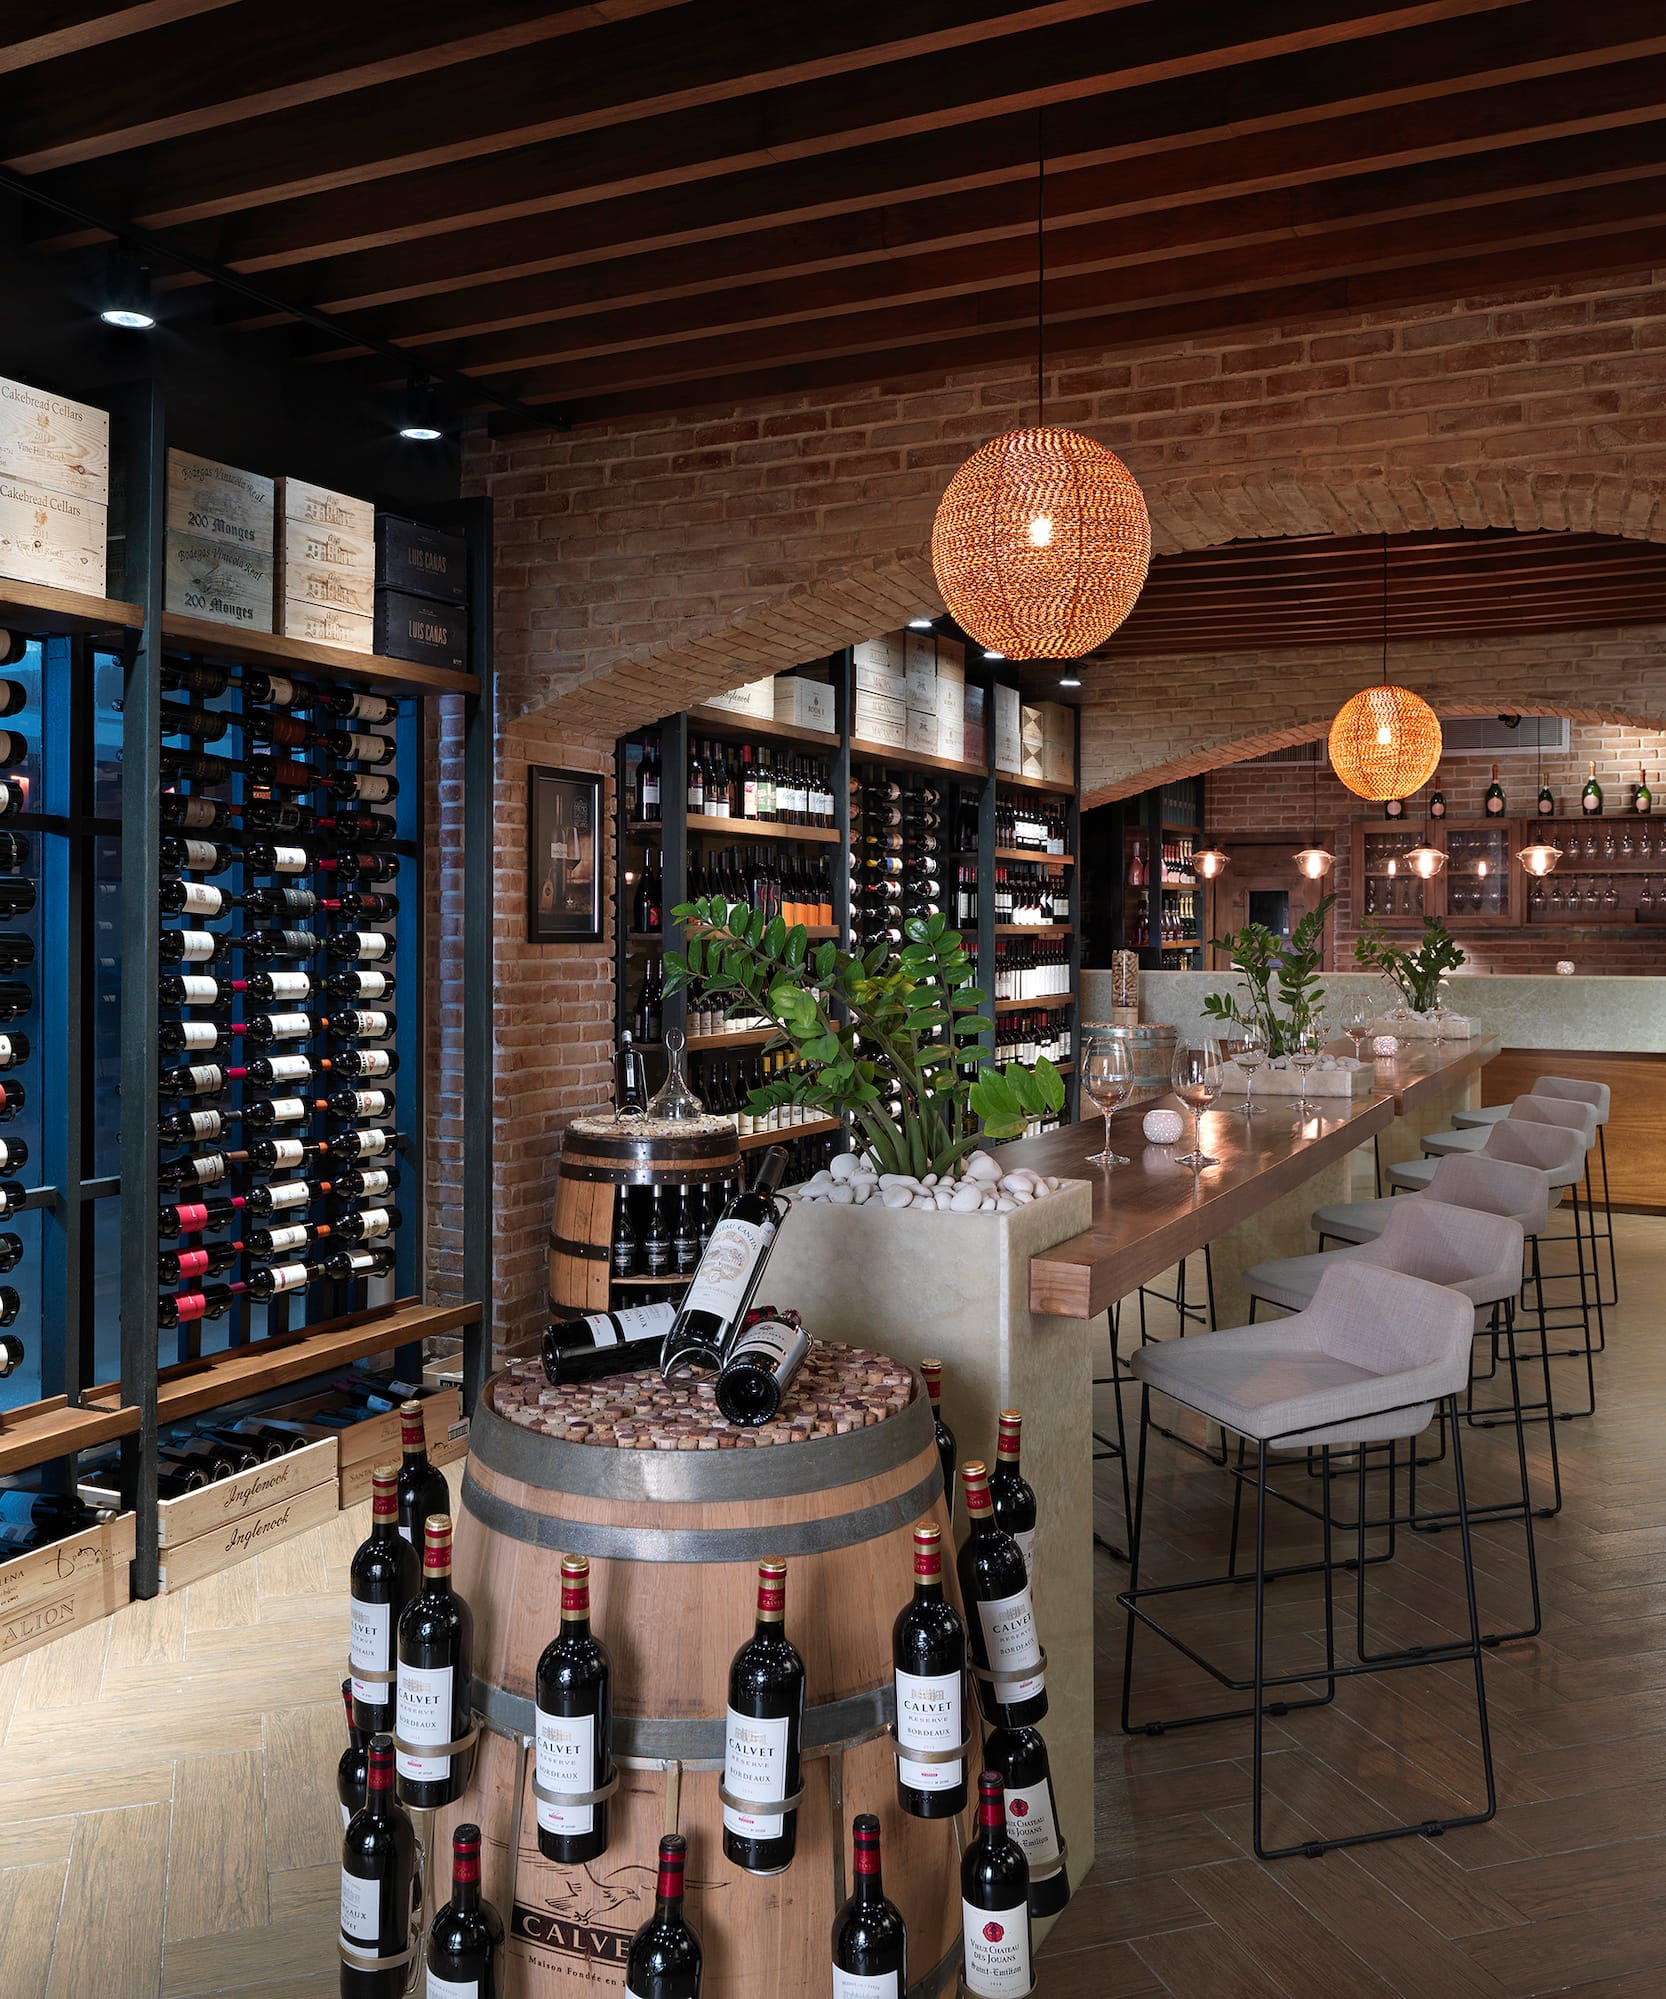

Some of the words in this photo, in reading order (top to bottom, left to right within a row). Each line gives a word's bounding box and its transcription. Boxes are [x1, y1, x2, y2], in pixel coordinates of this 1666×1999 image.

[1, 385, 50, 411] Cakebread
[51, 402, 84, 422] Cellars
[0, 484, 48, 508] Cakebread
[49, 498, 81, 517] Cellars
[187, 511, 209, 528] 200
[211, 518, 256, 542] Monges
[408, 546, 424, 567] LUIS
[183, 592, 206, 609] 200
[208, 597, 254, 621] Monges
[408, 620, 425, 640] LUIS
[223, 1464, 290, 1509] Inglenook
[224, 1506, 291, 1552] Inglenook
[2, 1599, 75, 1646] ALION
[992, 1612, 1032, 1635] CALVET
[999, 1629, 1032, 1642] RESERVE
[1000, 1637, 1035, 1656] BORDEAUX
[903, 1700, 953, 1713] CALVET
[908, 1714, 949, 1724] RESERVE
[907, 1726, 952, 1738] BORDEAUX
[537, 1736, 582, 1755] CALVET
[728, 1737, 776, 1758] CALVET
[540, 1752, 577, 1766] RESERVE
[731, 1754, 770, 1769] RESERVE
[538, 1763, 579, 1780] BORDEAUX
[729, 1766, 771, 1783] BORDEAUX
[522, 1914, 630, 1959] CALVE
[528, 1955, 563, 1973] Maison
[566, 1966, 602, 1983] Fondée
[605, 1977, 617, 1987] en
